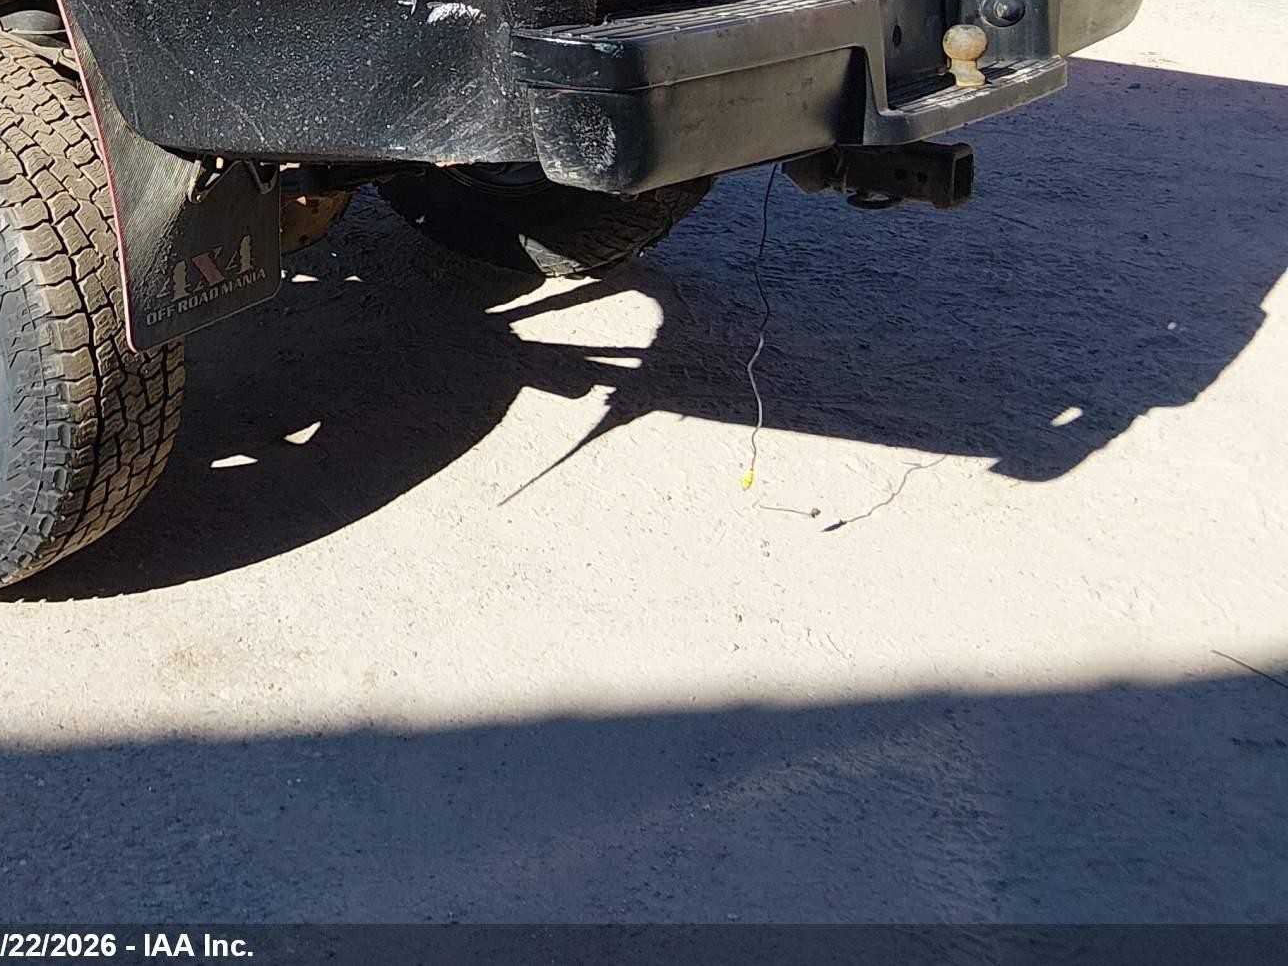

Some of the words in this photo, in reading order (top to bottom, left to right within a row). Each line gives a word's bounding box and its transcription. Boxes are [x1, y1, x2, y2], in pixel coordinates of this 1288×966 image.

[146, 305, 176, 326] OFF
[177, 288, 219, 314] ROAD
[221, 267, 266, 296] MANIA
